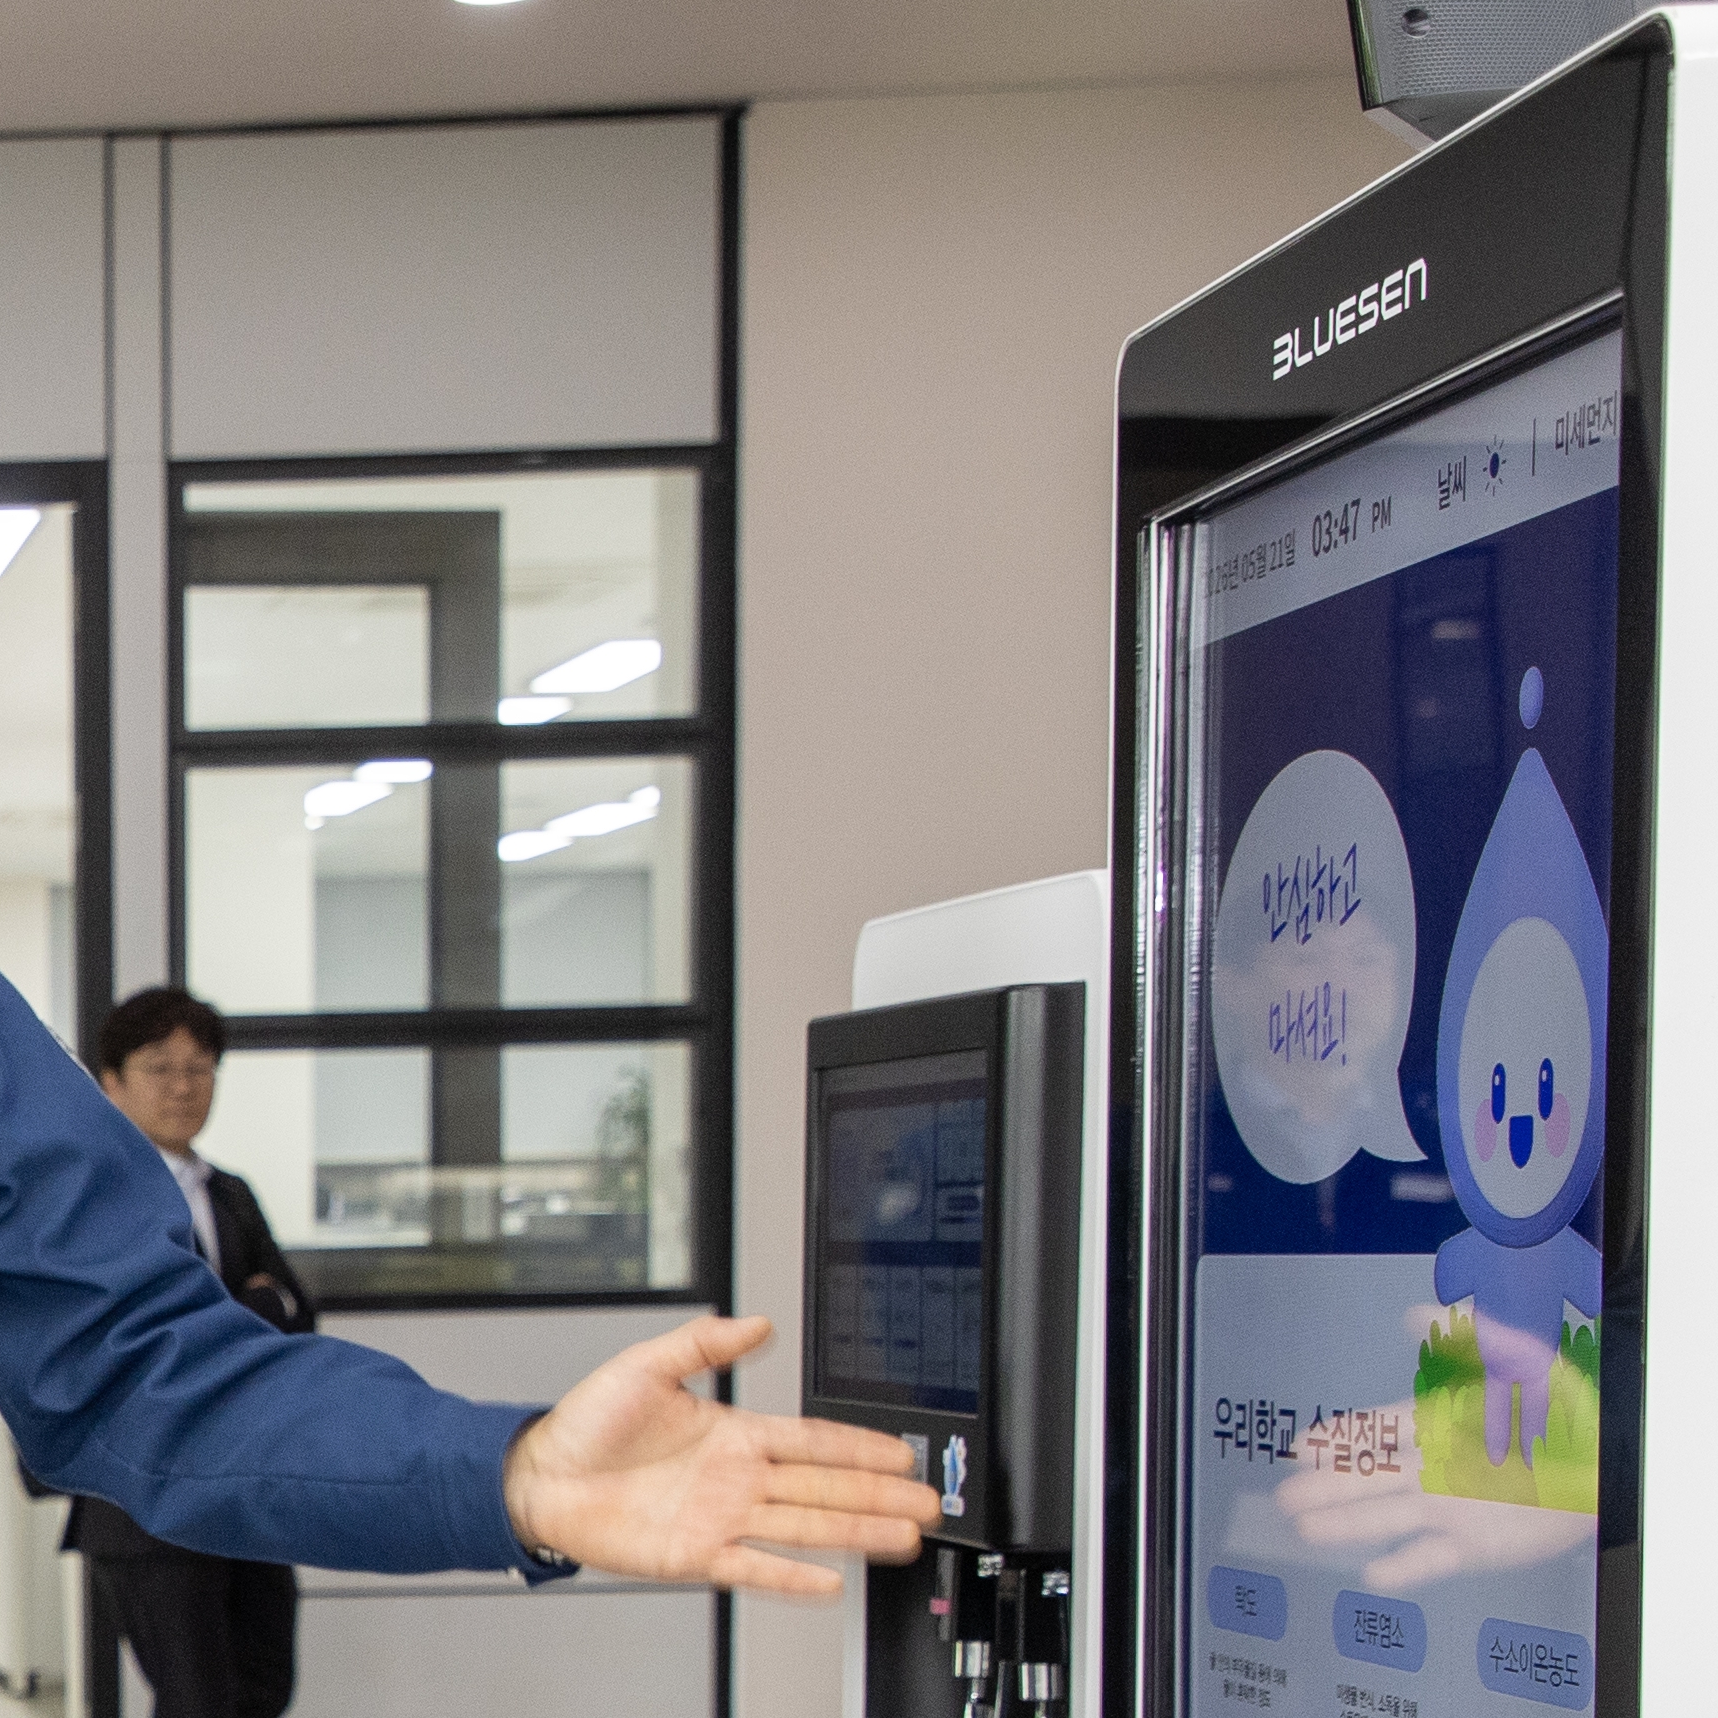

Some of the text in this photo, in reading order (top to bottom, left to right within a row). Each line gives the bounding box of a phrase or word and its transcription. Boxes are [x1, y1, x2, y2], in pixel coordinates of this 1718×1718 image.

[1272, 257, 1428, 382] BLUESEN
[1553, 389, 1620, 457] 미세먼지
[1241, 543, 1267, 583] 05월
[1269, 528, 1296, 571] 21일
[1312, 498, 1362, 559] 03:47
[1371, 495, 1392, 534] PM
[1437, 455, 1468, 512] 날씨
[1263, 842, 1361, 945] 안심하고
[1268, 980, 1347, 1067] 마셔요!
[1214, 1396, 1401, 1476] 우리학교 수질정보
[1354, 1609, 1405, 1649] 잔류염소
[1489, 1636, 1580, 1688] 수소이온농도
